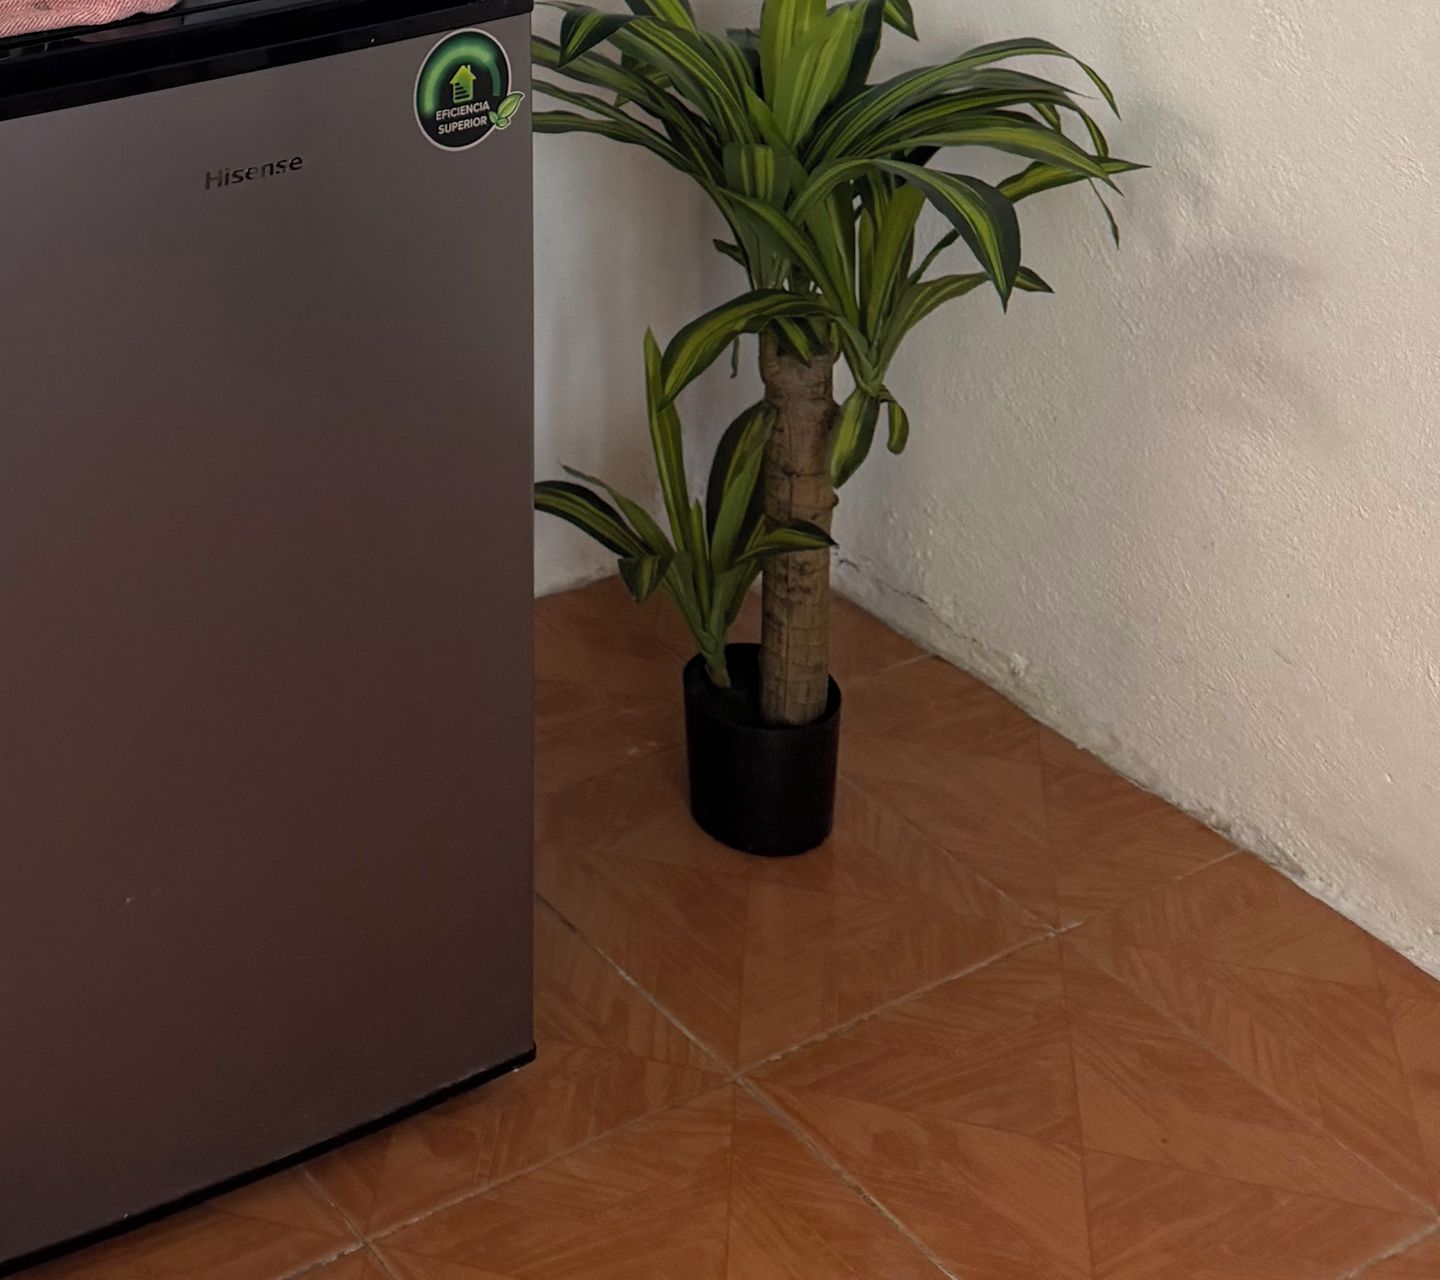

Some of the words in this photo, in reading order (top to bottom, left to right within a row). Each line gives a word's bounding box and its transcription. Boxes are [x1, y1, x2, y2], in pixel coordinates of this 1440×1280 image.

[435, 100, 491, 121] EFICIENCIA
[438, 115, 487, 135] SUPERIOR
[204, 156, 304, 190] Hisense
